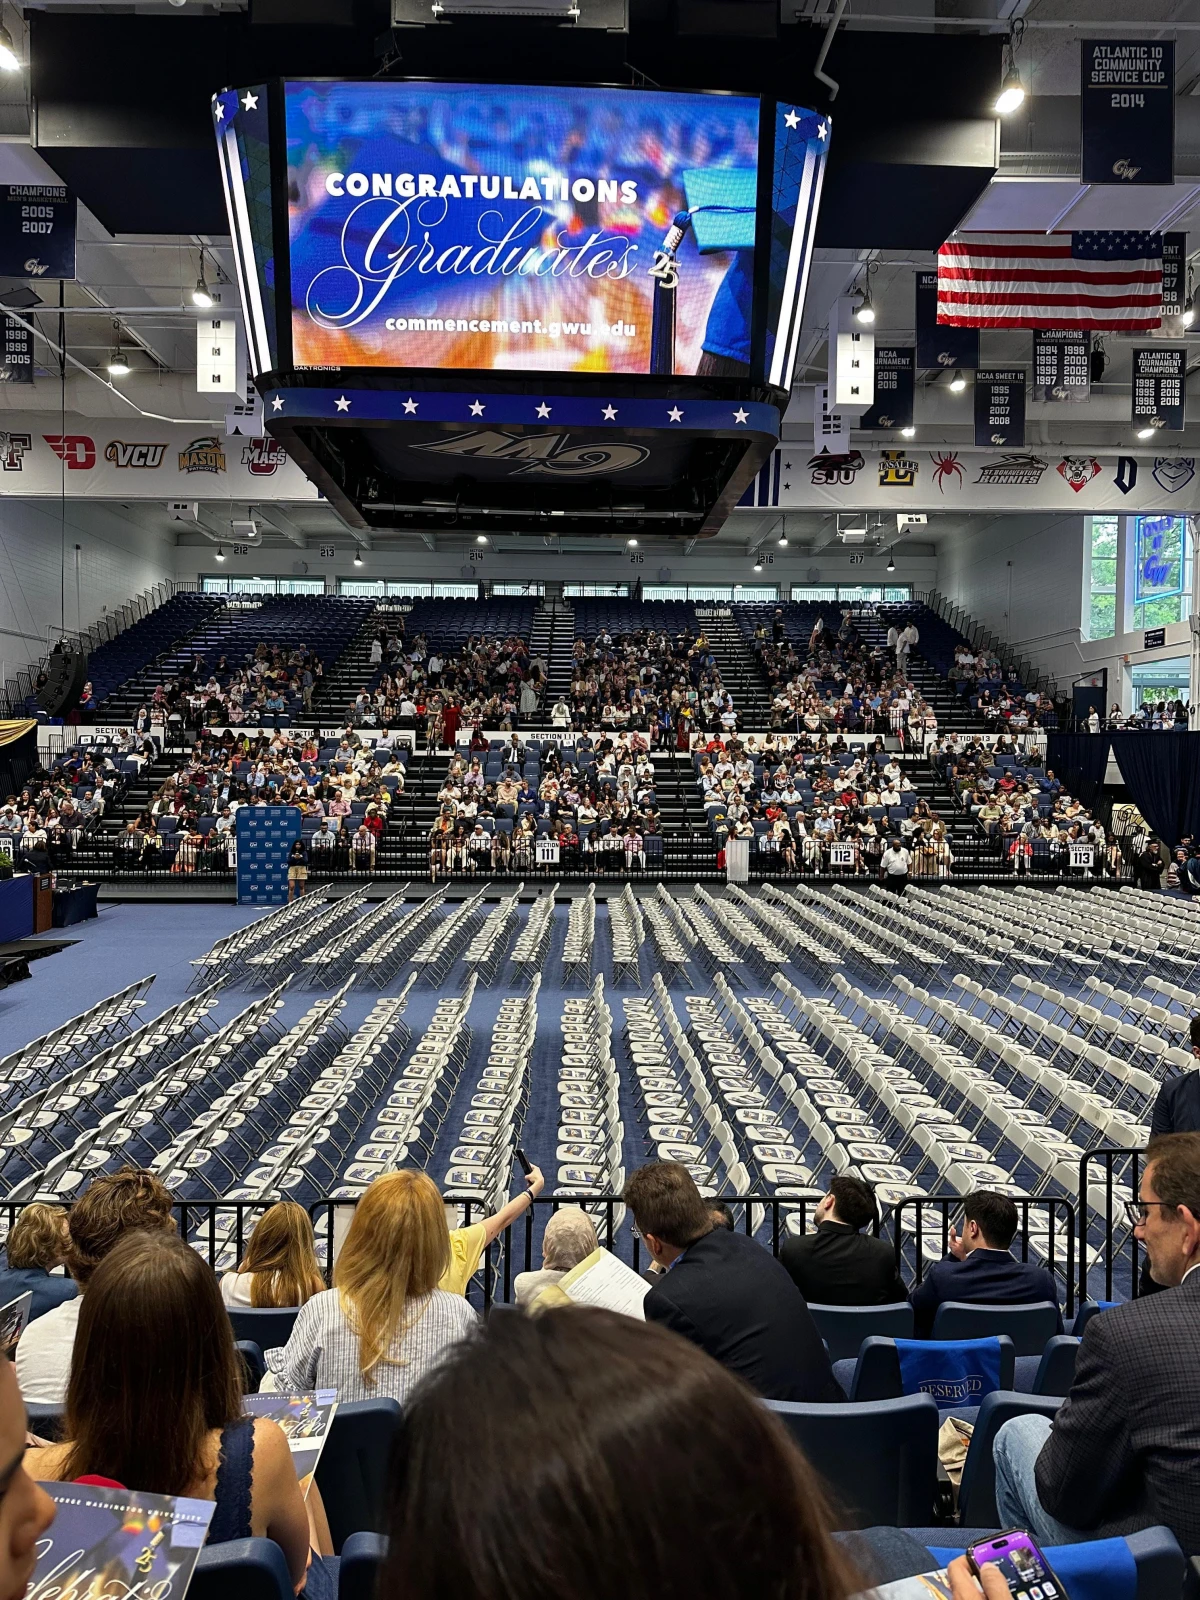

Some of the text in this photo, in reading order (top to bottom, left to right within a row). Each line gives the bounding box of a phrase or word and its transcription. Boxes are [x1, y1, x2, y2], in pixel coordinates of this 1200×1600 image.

[1093, 46, 1163, 58] ATLANTIC 10
[1094, 59, 1162, 71] COMMUNITY
[1091, 71, 1165, 83] SERVICE CUP
[1111, 93, 1145, 108] 2014
[9, 186, 66, 197] CHAMPIONS
[325, 172, 638, 204] CONGRATULATIONS
[21, 205, 54, 218] 2005
[22, 221, 54, 234] 2007
[306, 191, 639, 329] Graduates
[922, 276, 938, 284] NCA
[1160, 305, 1180, 315] 000
[385, 317, 636, 338] commencement.gwu.edu
[6, 331, 27, 339] 1998
[6, 342, 27, 351] 1999
[1037, 346, 1057, 354] 1994
[1064, 346, 1084, 354] 1998
[6, 355, 30, 363] 2005
[1037, 356, 1057, 364] 1995
[1064, 356, 1087, 364] 2000
[1037, 366, 1057, 374] 1996
[1064, 366, 1087, 375] 2002
[878, 372, 897, 380] 2016
[1037, 376, 1056, 385] 1997
[1064, 376, 1086, 385] 2003
[878, 381, 897, 389] 2018
[1136, 379, 1155, 387] 1992
[1136, 388, 1154, 396] 1995
[991, 396, 1009, 404] 1997
[1136, 397, 1154, 405] 1996
[1136, 406, 1156, 414] 2003
[989, 417, 1010, 425] 2008
[112, 442, 169, 467] VCU
[179, 452, 226, 471] MASON
[811, 469, 855, 485] SJU
[979, 475, 1039, 484] BONNIES
[233, 547, 248, 555] 212
[321, 549, 335, 557] 213
[760, 555, 773, 563] 216
[850, 555, 864, 563] 217
[542, 849, 553, 860] 111
[835, 851, 850, 861] 112
[1074, 853, 1090, 864] 113
[52, 1496, 202, 1522] EORGE WASHINGTON UNIVERSITY
